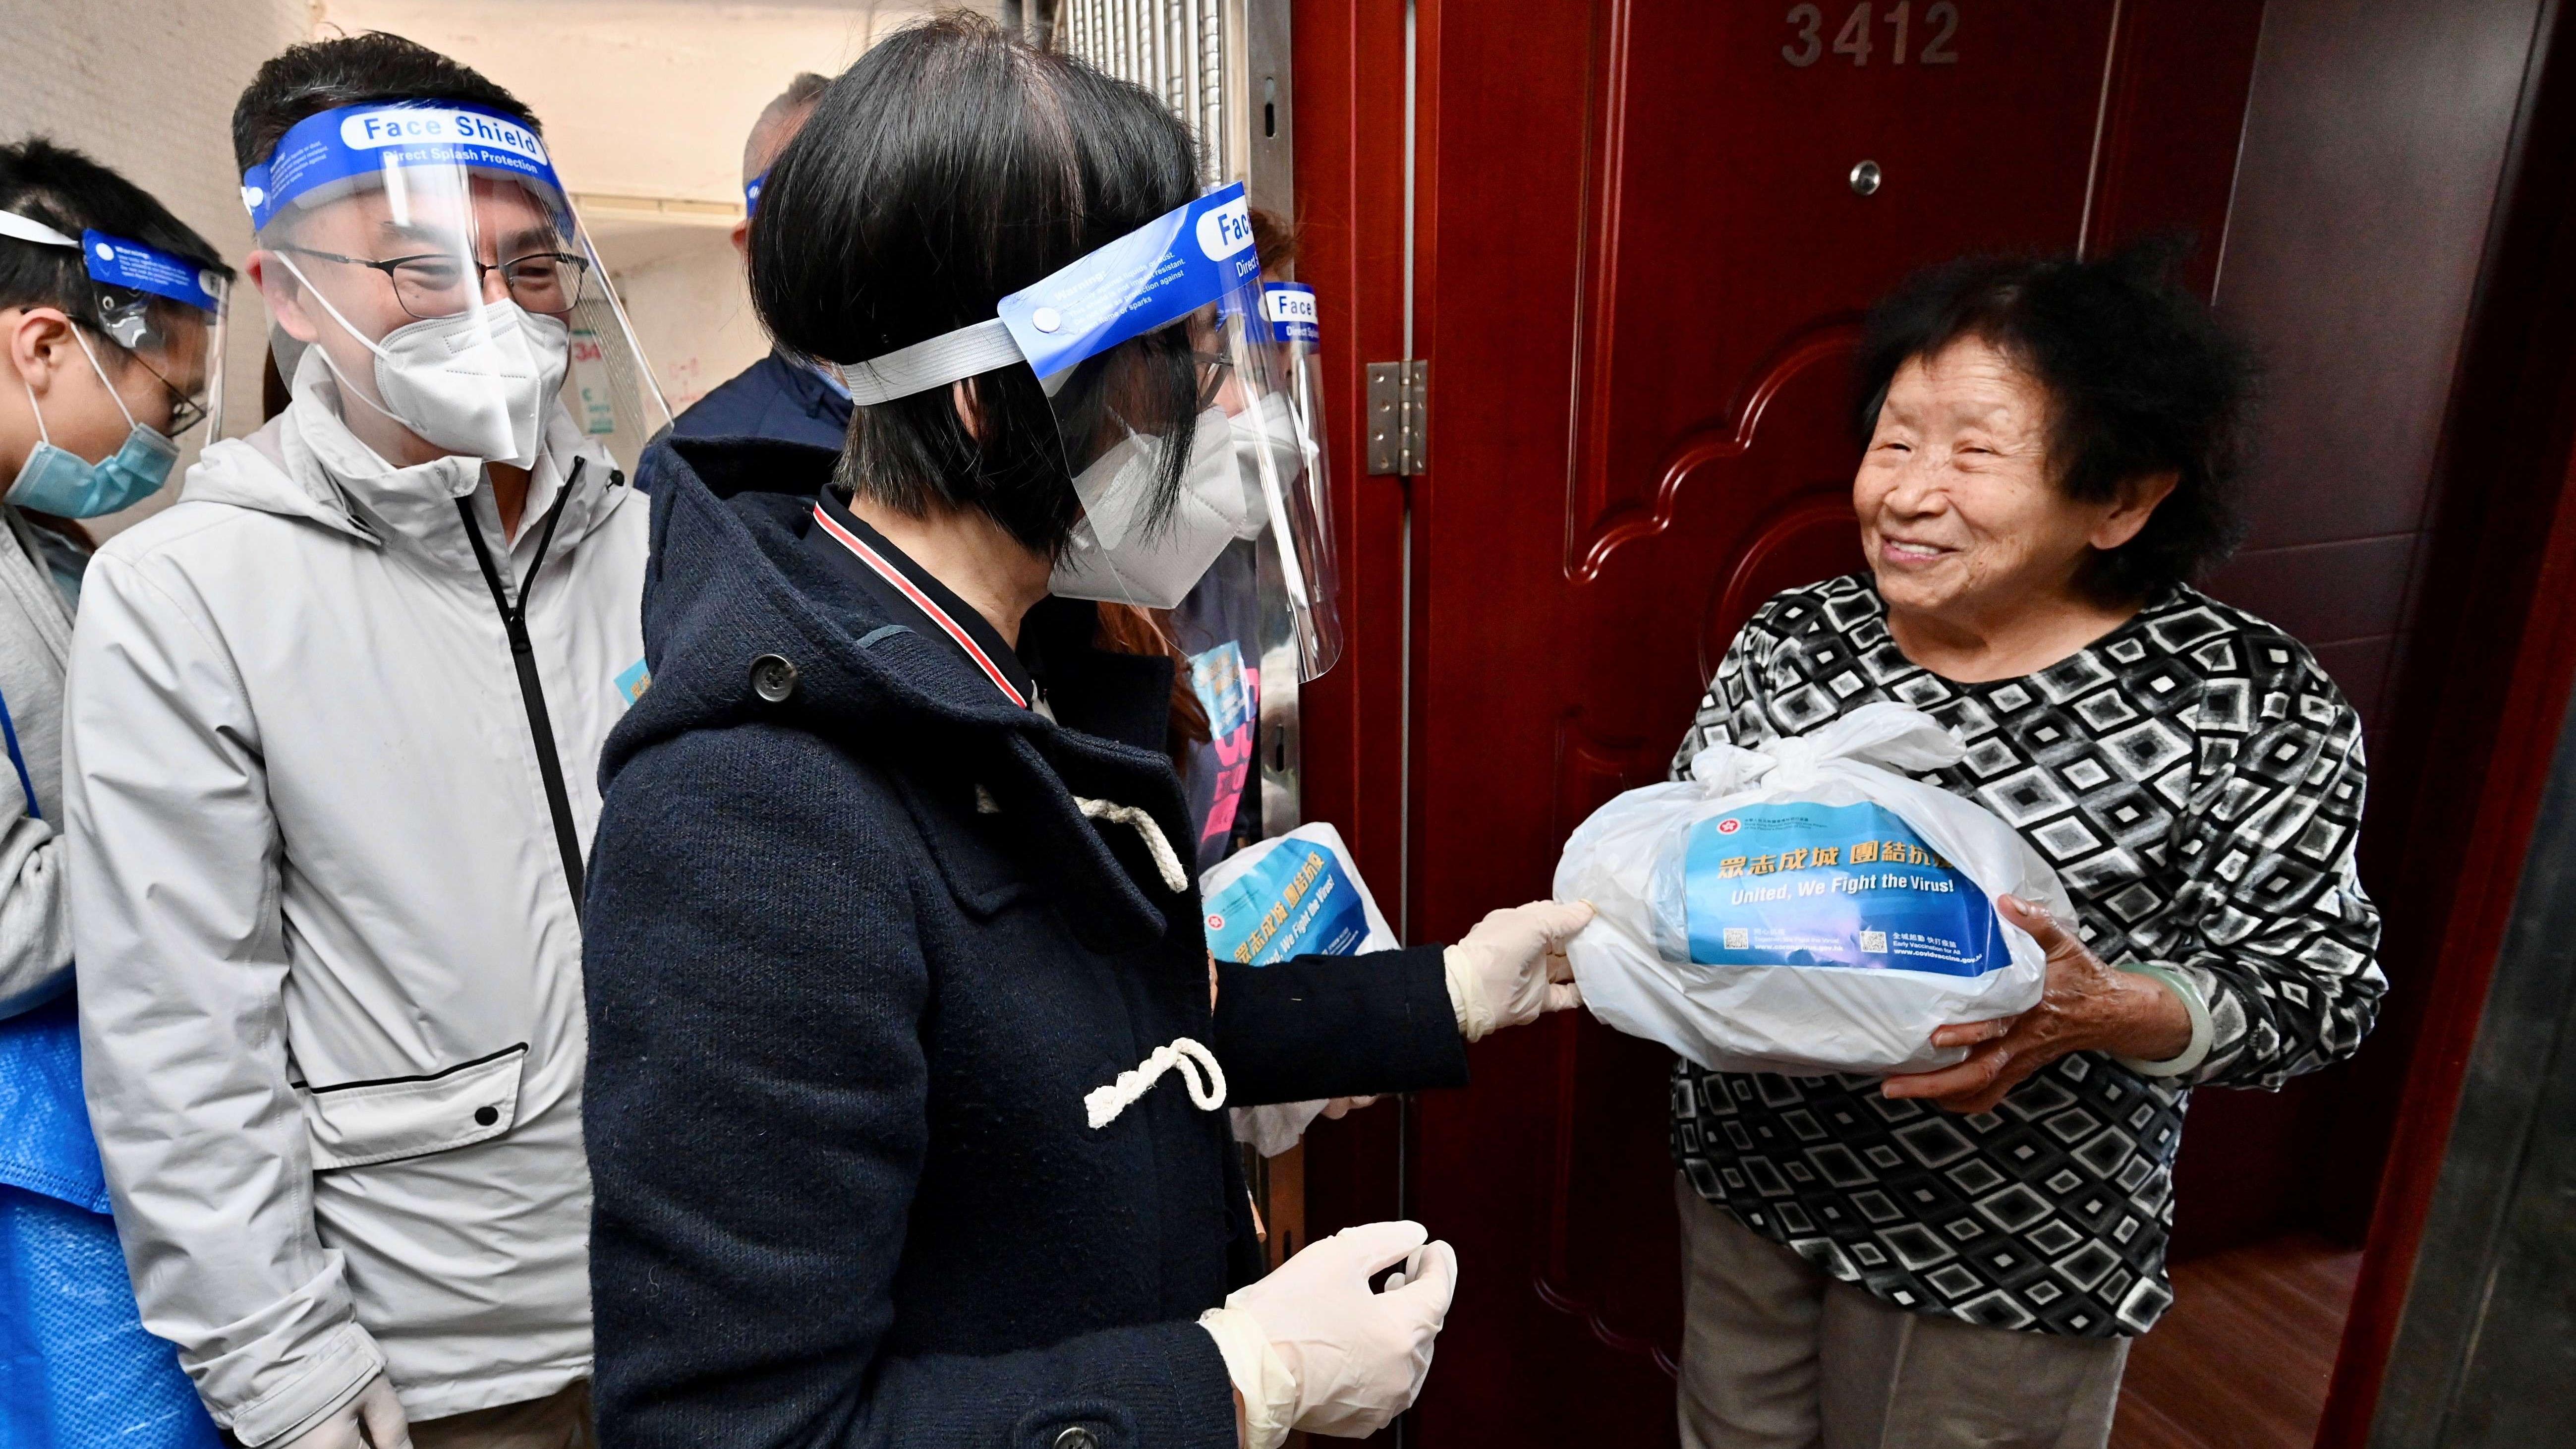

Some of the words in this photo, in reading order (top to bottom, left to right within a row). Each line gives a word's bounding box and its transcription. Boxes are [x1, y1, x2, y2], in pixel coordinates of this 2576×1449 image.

[1782, 1, 1959, 67] 3412
[364, 118, 441, 139] Face
[456, 116, 536, 155] Shield
[430, 147, 478, 161] Splash
[481, 150, 538, 174] Protection
[1122, 264, 1147, 279] liquids
[1130, 271, 1155, 287] impact
[1155, 258, 1186, 276] resistant.
[1236, 254, 1257, 278] Direct
[1124, 281, 1159, 302] protection
[1160, 269, 1184, 285] against
[1120, 305, 1128, 314] or
[1129, 296, 1152, 310] sparks
[1279, 295, 1312, 315] Face
[1717, 847, 1839, 879] 眾志成城
[1731, 884, 1792, 906] United,
[1797, 880, 1826, 897] We
[1832, 874, 1877, 894] Fight
[1882, 873, 1907, 889] the
[1910, 875, 1954, 892] Virus!
[1909, 942, 1943, 952] Vaccination
